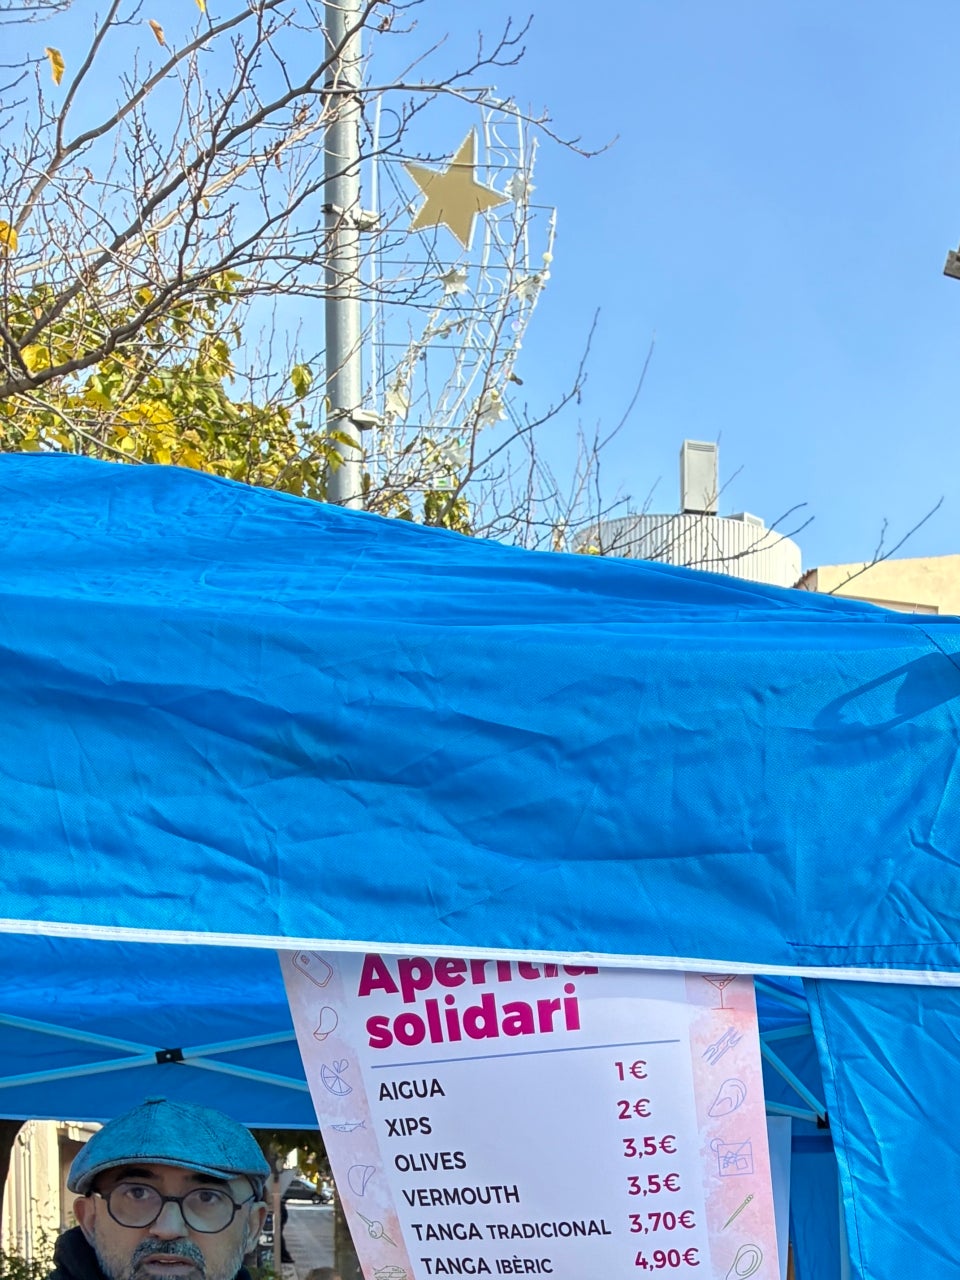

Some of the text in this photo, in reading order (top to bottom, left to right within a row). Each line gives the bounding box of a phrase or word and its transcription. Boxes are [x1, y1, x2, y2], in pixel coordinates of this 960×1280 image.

[358, 953, 599, 1003] Aperit
[366, 983, 580, 1049] solidari
[379, 1060, 648, 1101] AIGUA 1€
[384, 1098, 652, 1137] XIPS 2€
[394, 1135, 677, 1172] OLIVES 3,5€
[402, 1173, 681, 1207] VERMOUTH 3,5€
[411, 1210, 696, 1241] TANGA TRADICIONAL 3,70€
[421, 1248, 700, 1275] TANGA IBÈRIC 4,90€
